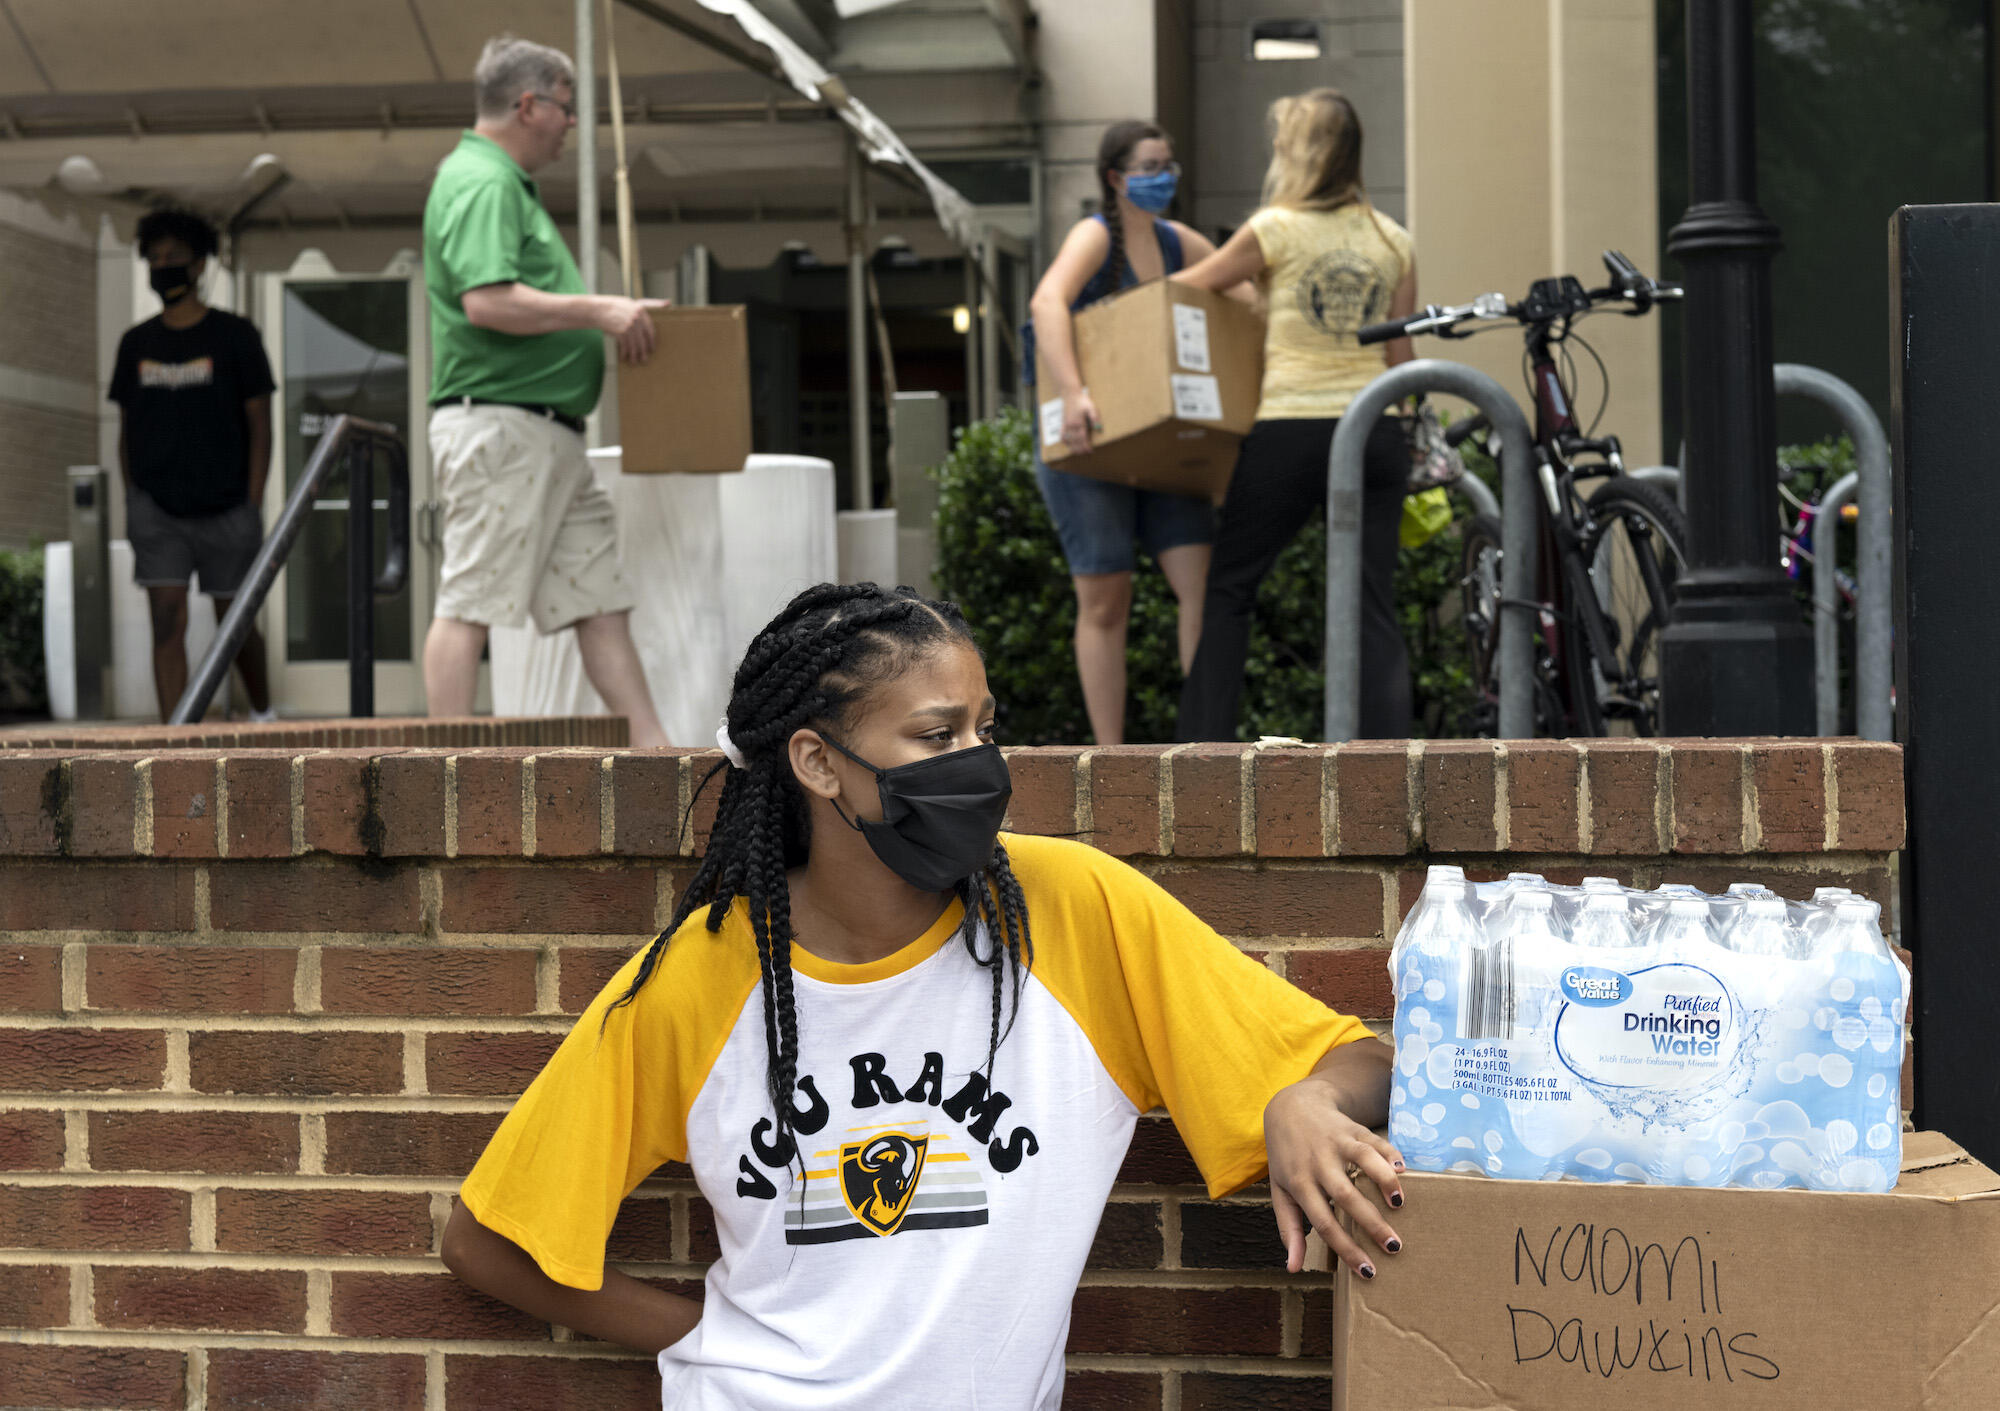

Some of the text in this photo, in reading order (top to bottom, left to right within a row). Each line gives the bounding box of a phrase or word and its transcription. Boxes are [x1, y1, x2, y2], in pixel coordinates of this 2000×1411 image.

[1566, 972, 1620, 990] Great
[1577, 986, 1620, 1000] Value
[1664, 994, 1721, 1015] Purified
[1624, 1013, 1720, 1040] Drinking
[1455, 1047, 1465, 1056] 24
[1472, 1048, 1489, 1058] 16.9
[1489, 1048, 1497, 1057] FL
[1498, 1048, 1508, 1059] OZ
[1651, 1034, 1721, 1056] Water
[1454, 1058, 1511, 1074] (1 PT 0.9 FL OZ)
[1599, 1055, 1618, 1063] With
[1620, 1056, 1643, 1065] Flavor
[1688, 1059, 1719, 1068] Minerals
[1453, 1069, 1557, 1088] 500mL BOTTLES 405.6 FL OZ
[1452, 1080, 1461, 1089] (3
[1462, 1081, 1478, 1091] GAL
[1486, 1087, 1496, 1096] PT
[1496, 1088, 1508, 1099] 5.6
[1509, 1091, 1518, 1100] FL
[1519, 1090, 1532, 1101] OZ)
[1534, 1091, 1543, 1101] 12
[1544, 1091, 1549, 1101] L
[1550, 1091, 1572, 1101] TOTAL
[737, 1052, 1039, 1199] VCU RAMS
[1515, 1223, 1722, 1314] Naomi
[1507, 1304, 1780, 1380] Dawkins
